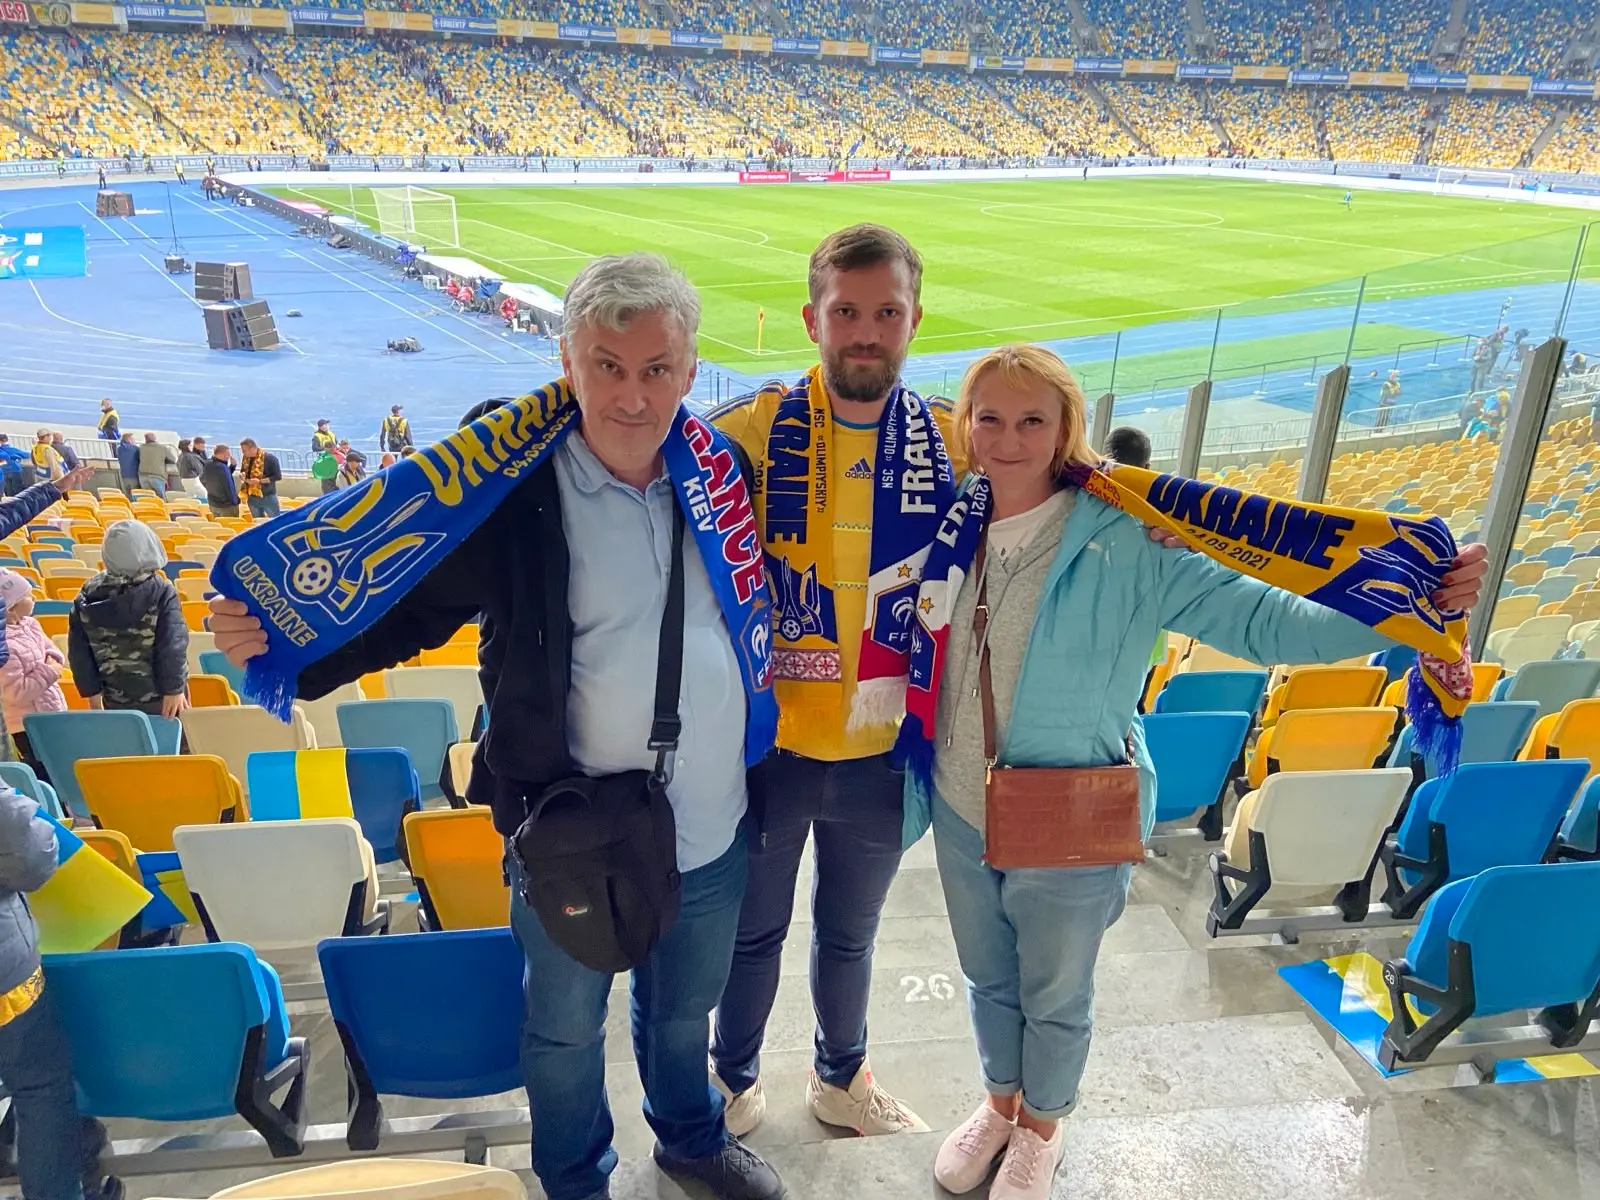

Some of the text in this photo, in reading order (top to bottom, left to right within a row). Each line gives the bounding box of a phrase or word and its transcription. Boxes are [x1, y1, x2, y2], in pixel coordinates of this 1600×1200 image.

[813, 408, 825, 428] NSC
[881, 468, 895, 489] NSC
[682, 476, 714, 532] KIEV
[1146, 473, 1355, 570] UKRAINE
[232, 555, 319, 647] UKRAINE
[900, 974, 955, 1003] 26
